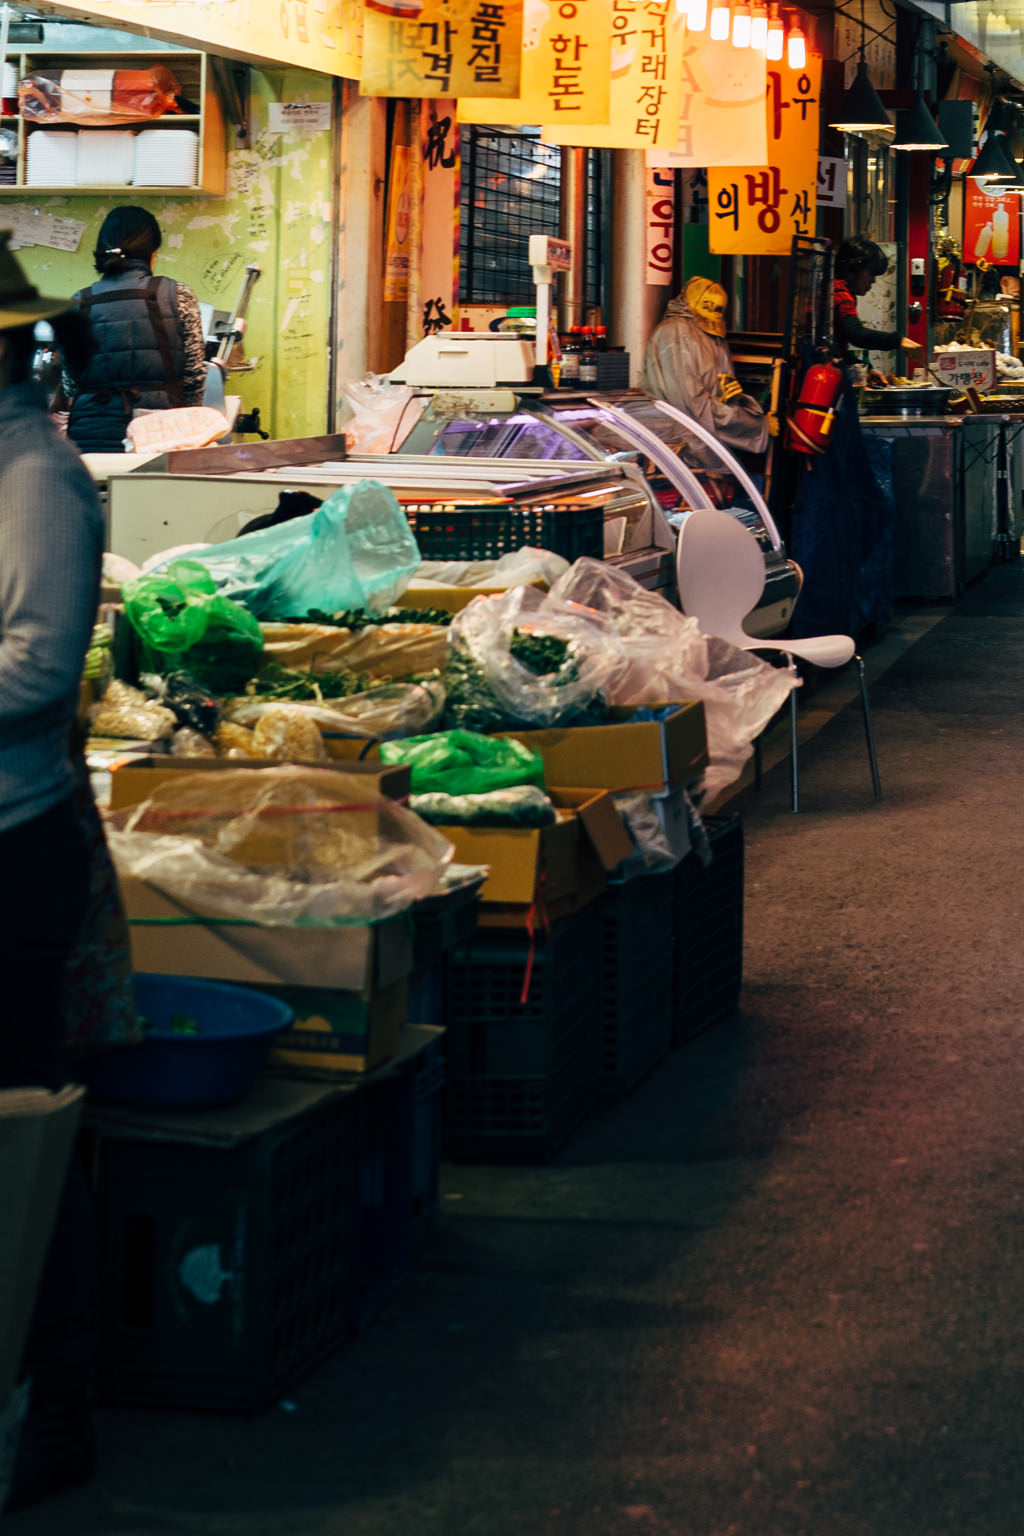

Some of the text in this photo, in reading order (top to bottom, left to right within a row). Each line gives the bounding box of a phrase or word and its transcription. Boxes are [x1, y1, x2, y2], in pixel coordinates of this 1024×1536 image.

[420, 21, 459, 92] 가격
[467, 3, 507, 83] 품질
[548, 34, 589, 112] 한돈
